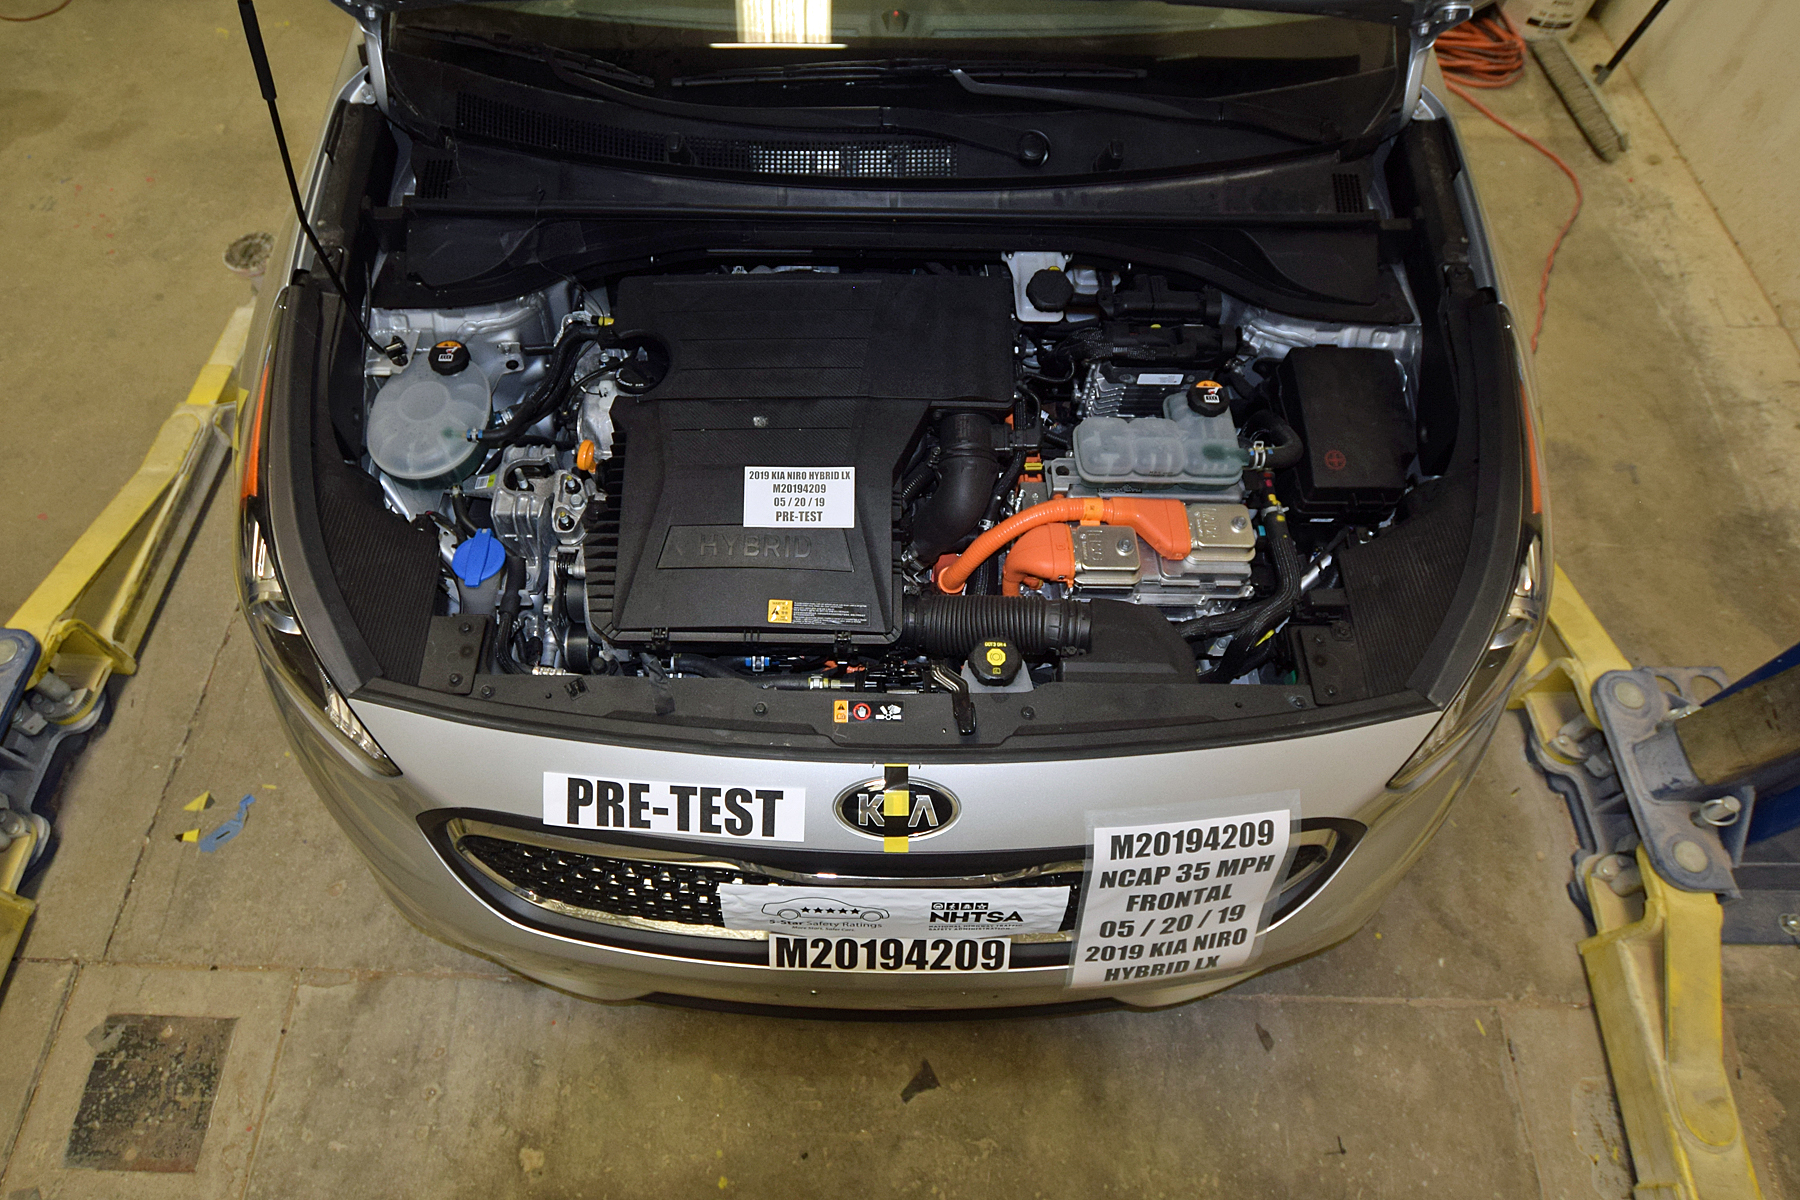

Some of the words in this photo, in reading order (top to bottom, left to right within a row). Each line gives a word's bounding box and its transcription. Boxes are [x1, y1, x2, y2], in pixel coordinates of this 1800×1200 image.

[749, 471, 769, 480] 2019
[771, 471, 785, 480] KIA
[787, 471, 807, 480] NIRO
[808, 471, 839, 480] HYBRID
[841, 471, 850, 480] LX
[773, 484, 826, 493] M20194209
[774, 497, 786, 507] 05
[788, 498, 792, 507] /
[794, 497, 806, 507] 20
[808, 498, 812, 507] /
[815, 497, 825, 507] 19
[776, 511, 823, 522] PRE-TEST
[700, 534, 812, 558] HYBRID
[567, 777, 784, 838] PRE-TEST
[1110, 820, 1274, 860] M20194209
[1099, 866, 1171, 889] NCAP
[1175, 862, 1211, 883] 35
[1215, 855, 1276, 878] MPH
[1126, 884, 1233, 912] FRONTAL
[930, 911, 1024, 923] NHTSA
[1099, 920, 1135, 938] 05
[1139, 918, 1156, 937] /
[1159, 914, 1194, 935] 20
[1196, 909, 1213, 929] /
[1217, 904, 1247, 924] 19
[776, 938, 1005, 971] M20194209
[1084, 944, 1144, 962] 2019
[1148, 938, 1188, 958] KIA
[1192, 927, 1248, 951] NIRO
[1104, 960, 1190, 982] HYBRID
[1194, 955, 1221, 970] LX
